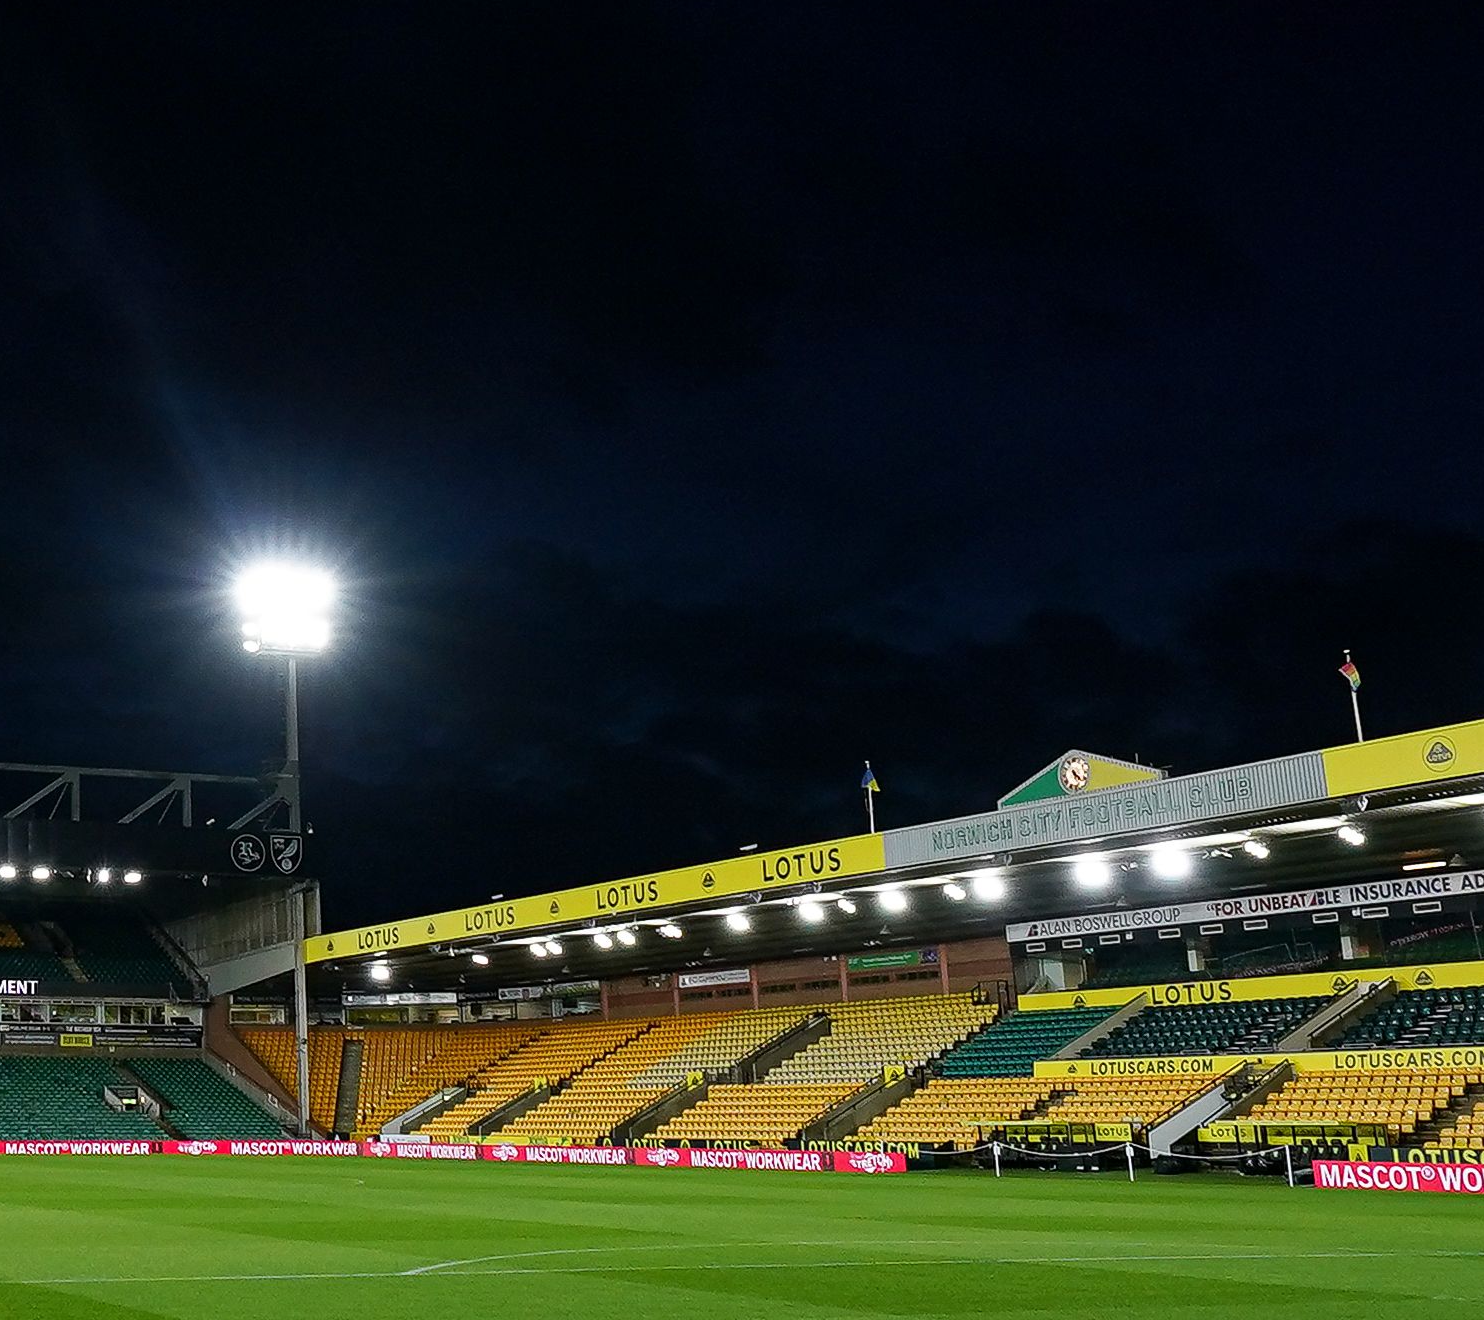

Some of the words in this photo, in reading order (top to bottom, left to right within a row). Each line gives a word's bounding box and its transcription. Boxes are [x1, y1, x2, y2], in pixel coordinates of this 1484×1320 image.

[932, 819, 1012, 853] NORWICH
[1020, 810, 1063, 837] CITY
[1070, 789, 1180, 828] FOOTBALL
[1191, 777, 1253, 808] CLUB
[762, 848, 842, 883] LOTUS
[596, 880, 659, 911] LOTUS
[1040, 920, 1072, 936] ALAN
[1075, 913, 1130, 933] BOSWELL
[1131, 907, 1181, 927] GROUP
[1349, 879, 1454, 903] INSURANCE
[465, 907, 515, 932] LOTUS
[357, 926, 399, 950] LOTUS
[1151, 982, 1233, 1006] LOTUS
[1090, 1057, 1214, 1077] LOTUSCARS.COM
[1097, 1126, 1129, 1137] LOTUS
[1210, 1126, 1247, 1139] LOTUS
[70, 1143, 150, 1155] WORKWEAR
[291, 1142, 357, 1155] WORKWEAR
[569, 1148, 627, 1165] WORKWEAR
[745, 1151, 822, 1171] WORKWEAR
